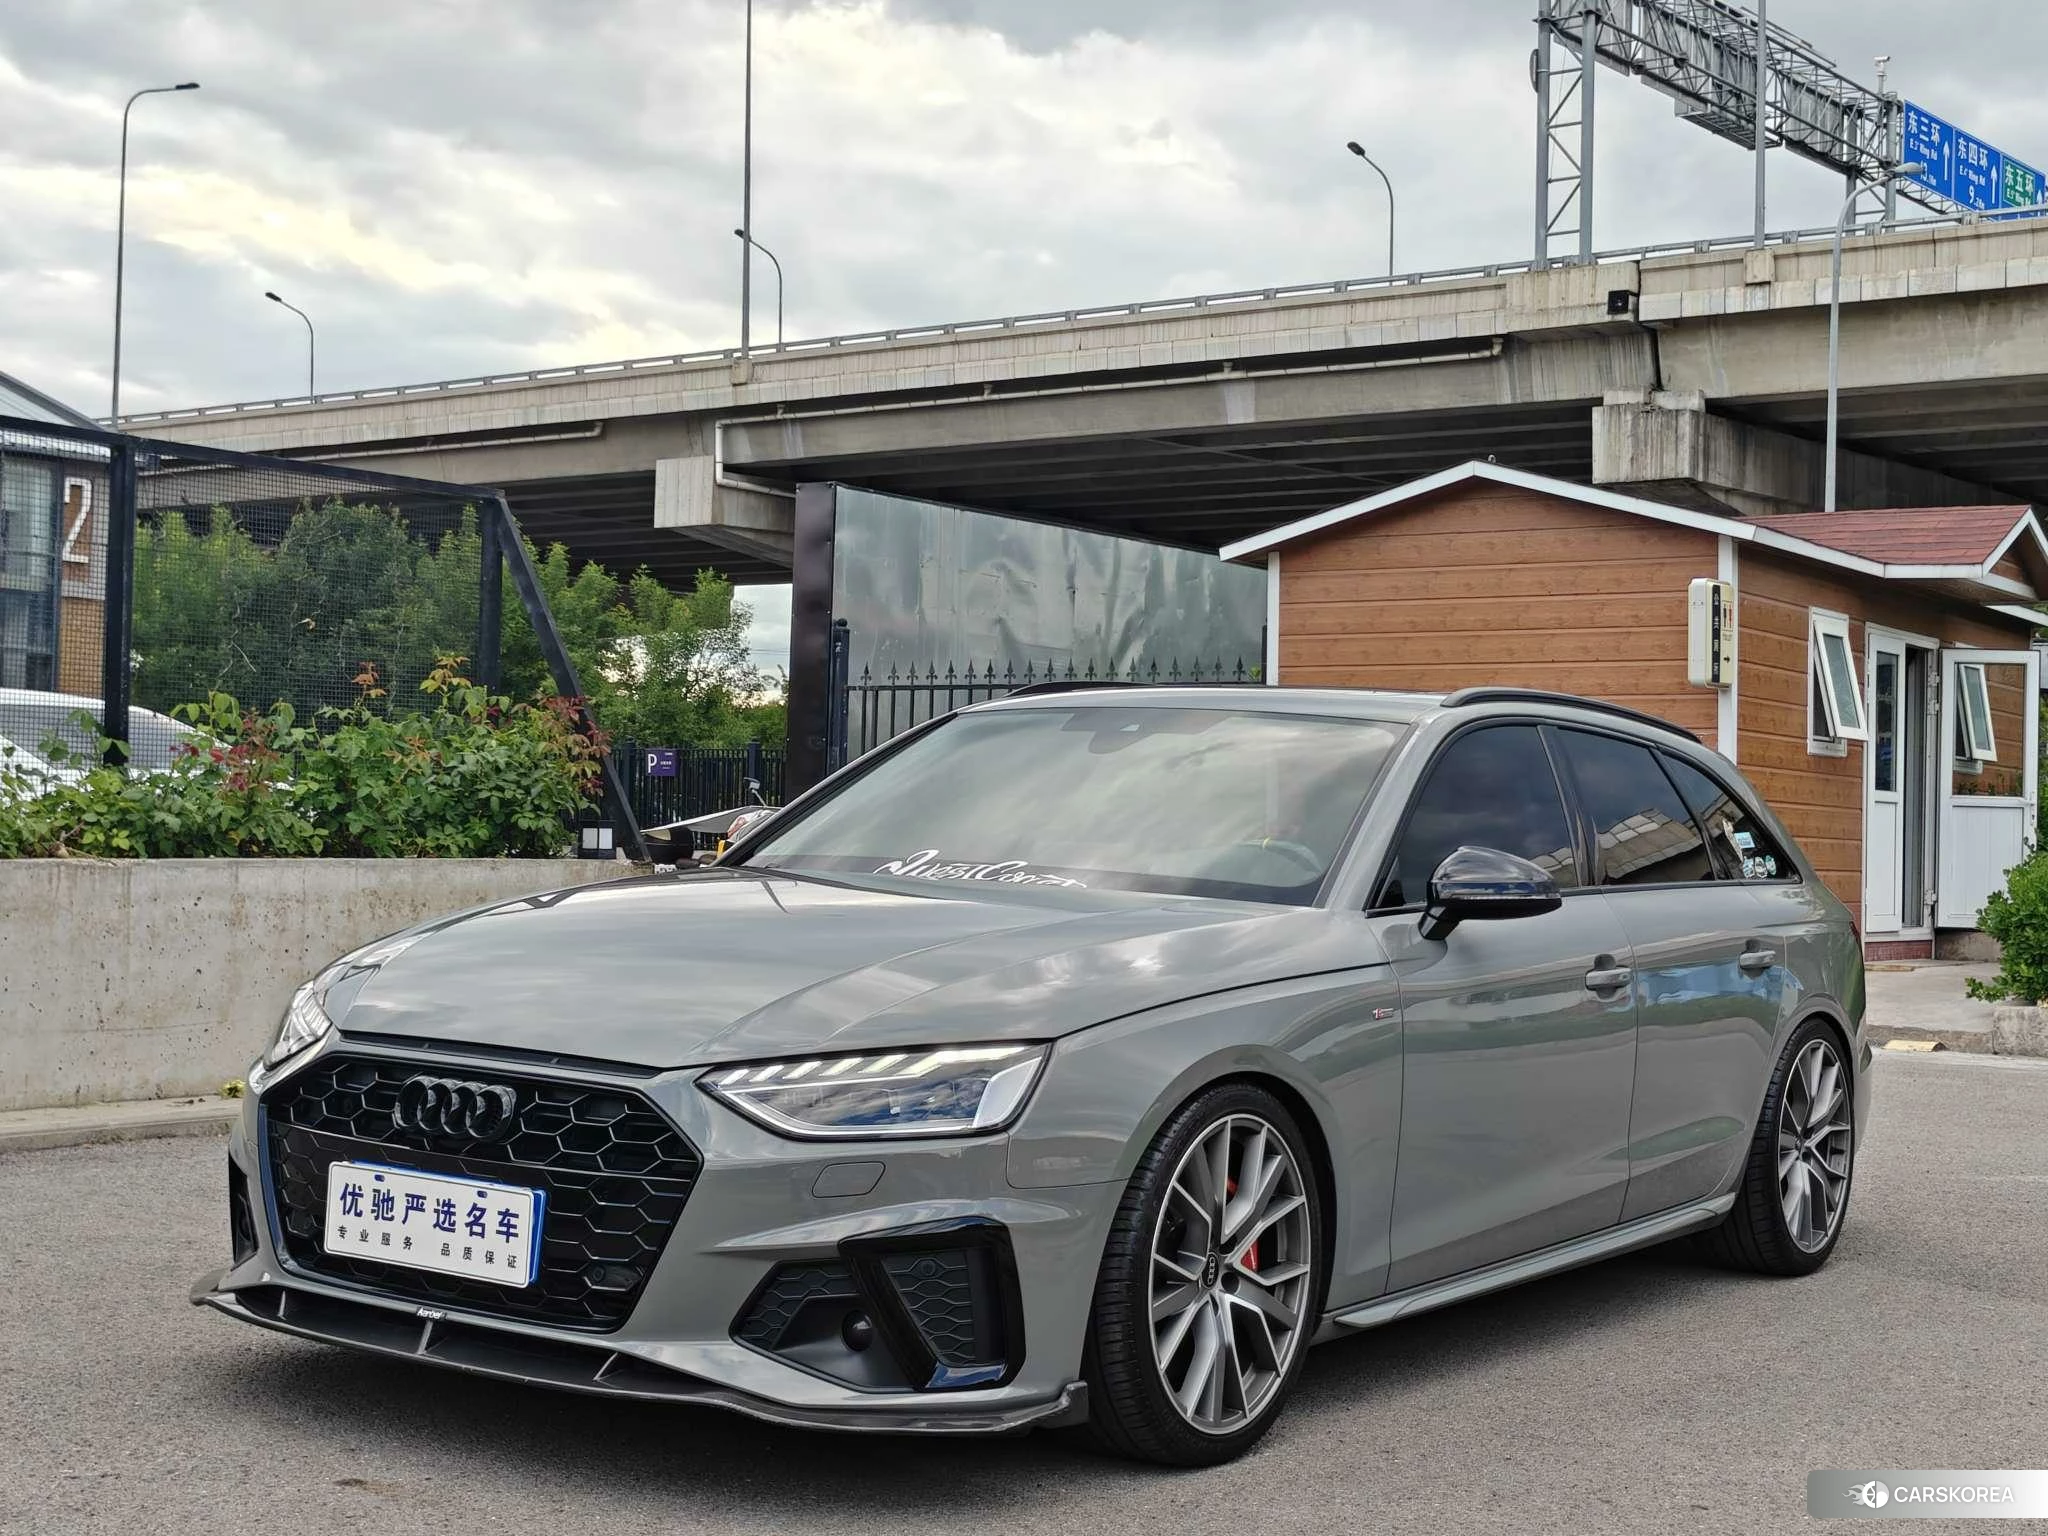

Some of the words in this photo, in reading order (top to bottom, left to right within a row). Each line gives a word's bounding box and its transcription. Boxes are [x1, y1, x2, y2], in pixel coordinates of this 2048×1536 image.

[1907, 110, 1941, 147] 东三环
[1957, 136, 1988, 171] 东四环
[2005, 163, 2034, 197] 东五环
[62, 476, 92, 564] 2
[647, 753, 657, 773] P
[339, 1182, 521, 1244] 优驰严选名车
[336, 1225, 413, 1251] 专业服务
[440, 1242, 518, 1269] 品质保证
